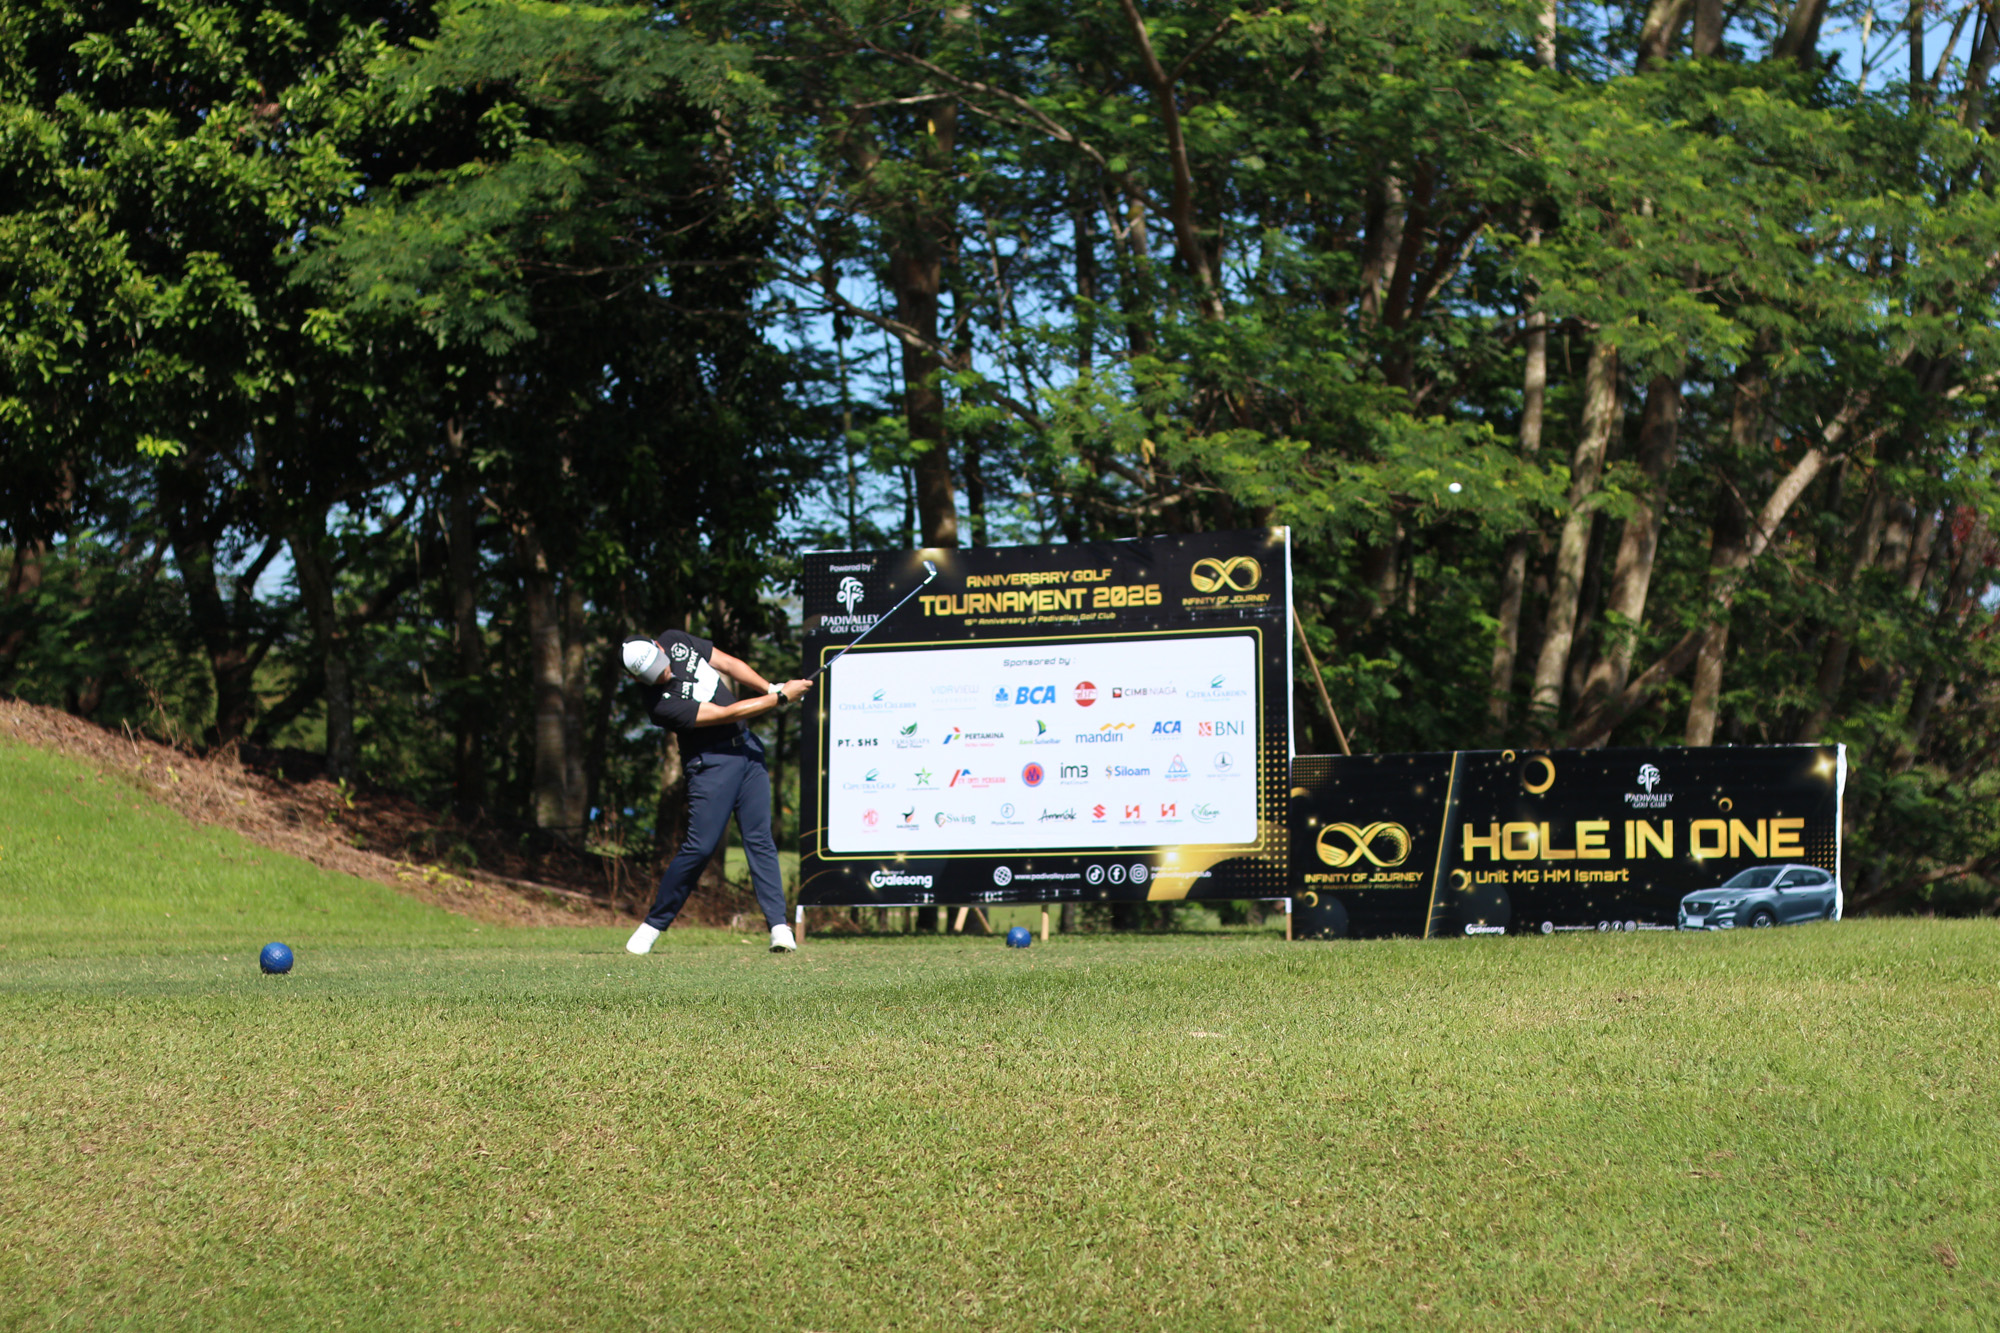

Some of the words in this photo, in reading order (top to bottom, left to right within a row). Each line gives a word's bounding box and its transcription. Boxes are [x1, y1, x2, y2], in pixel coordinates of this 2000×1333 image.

[829, 564, 860, 572] Powered
[861, 563, 871, 572] by
[966, 571, 1069, 588] ANNIVERSARY
[1072, 568, 1112, 582] GOLF
[918, 588, 1088, 616] TOURNAMENT
[1092, 584, 1163, 608] 2026
[1182, 596, 1215, 606] INFINITY
[1216, 595, 1229, 604] OF
[1230, 593, 1271, 603] JOURNEY
[820, 614, 879, 626] PADIVALLEY
[978, 616, 1027, 626] Anniversary
[1028, 615, 1037, 624] of
[1037, 613, 1079, 623] Padivalley
[1080, 612, 1096, 621] Golf
[1098, 611, 1116, 620] Club
[830, 625, 849, 634] GOLF
[1003, 657, 1056, 668] Sponsored
[1059, 657, 1071, 666] by
[1015, 685, 1056, 705] BCA
[1124, 687, 1148, 696] CIMB
[1150, 686, 1177, 696] NIAGA
[1151, 721, 1181, 734] ACA
[1215, 721, 1245, 736] BNI
[964, 732, 1005, 740] PERTAMINA
[1076, 730, 1123, 743] mandiri
[838, 739, 854, 748] PT.
[857, 738, 879, 747] SHS
[1114, 766, 1150, 776] Siloam
[1624, 793, 1674, 802] PADIVALLEY
[946, 814, 976, 824] Swing
[1462, 820, 1610, 861] HOLE
[1625, 819, 1674, 859] IN
[1689, 818, 1805, 858] ONE
[1014, 872, 1081, 881] www.padivalley.com
[1304, 873, 1350, 883] INFINITY
[1351, 873, 1368, 883] OF
[1369, 872, 1424, 882] JOURNEY
[1475, 870, 1510, 884] Unit
[1512, 869, 1540, 883] MG
[1543, 869, 1570, 882] HM
[1574, 868, 1629, 882] Ismart
